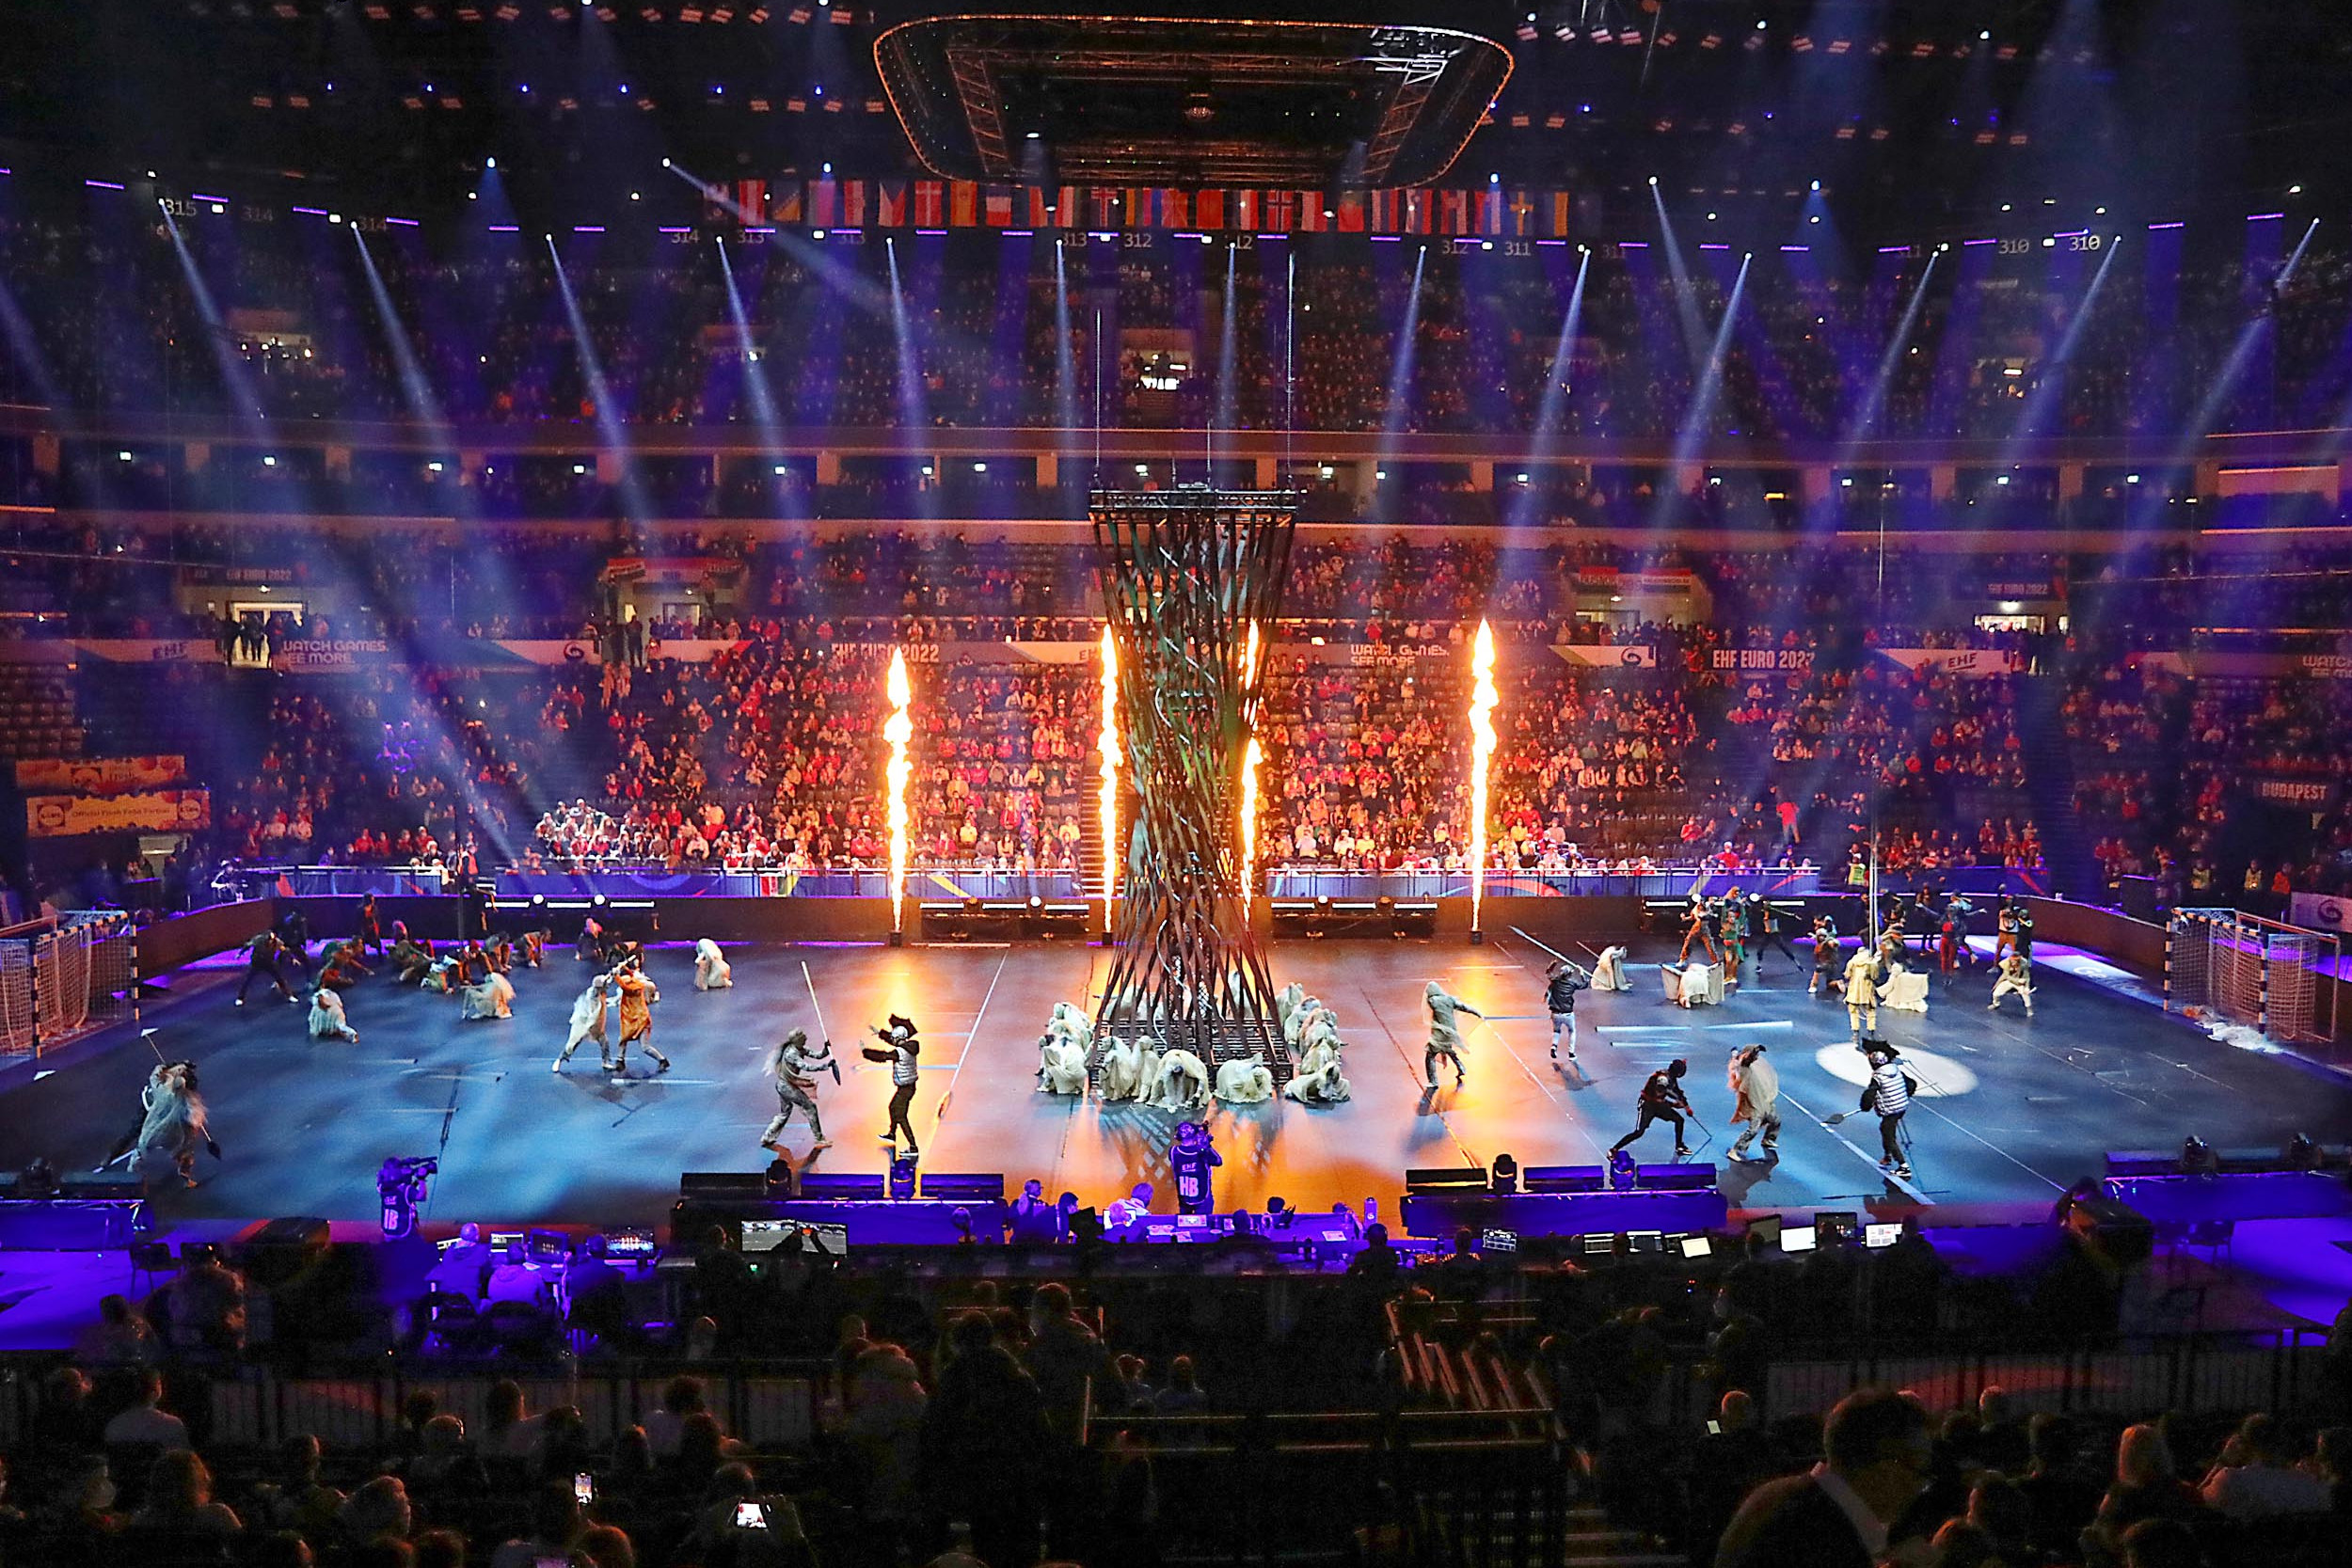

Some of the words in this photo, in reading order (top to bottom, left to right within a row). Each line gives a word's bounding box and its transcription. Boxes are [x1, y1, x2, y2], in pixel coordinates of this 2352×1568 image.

[166, 198, 198, 216] 315
[242, 205, 274, 222] 314
[671, 230, 700, 244] 314
[738, 230, 765, 245] 313
[1123, 233, 1152, 248] 312
[2069, 234, 2101, 251] 310
[1441, 240, 1470, 255] 312
[1504, 242, 1532, 257] 311
[1998, 238, 2030, 255] 310
[288, 653, 306, 665] EE
[901, 643, 939, 662] 2022
[1712, 649, 1738, 669] EHF
[1740, 649, 1775, 669] EURO
[1948, 652, 1978, 669] EHF
[2262, 783, 2327, 800] BUDAPEST
[1179, 1176, 1200, 1197] HB
